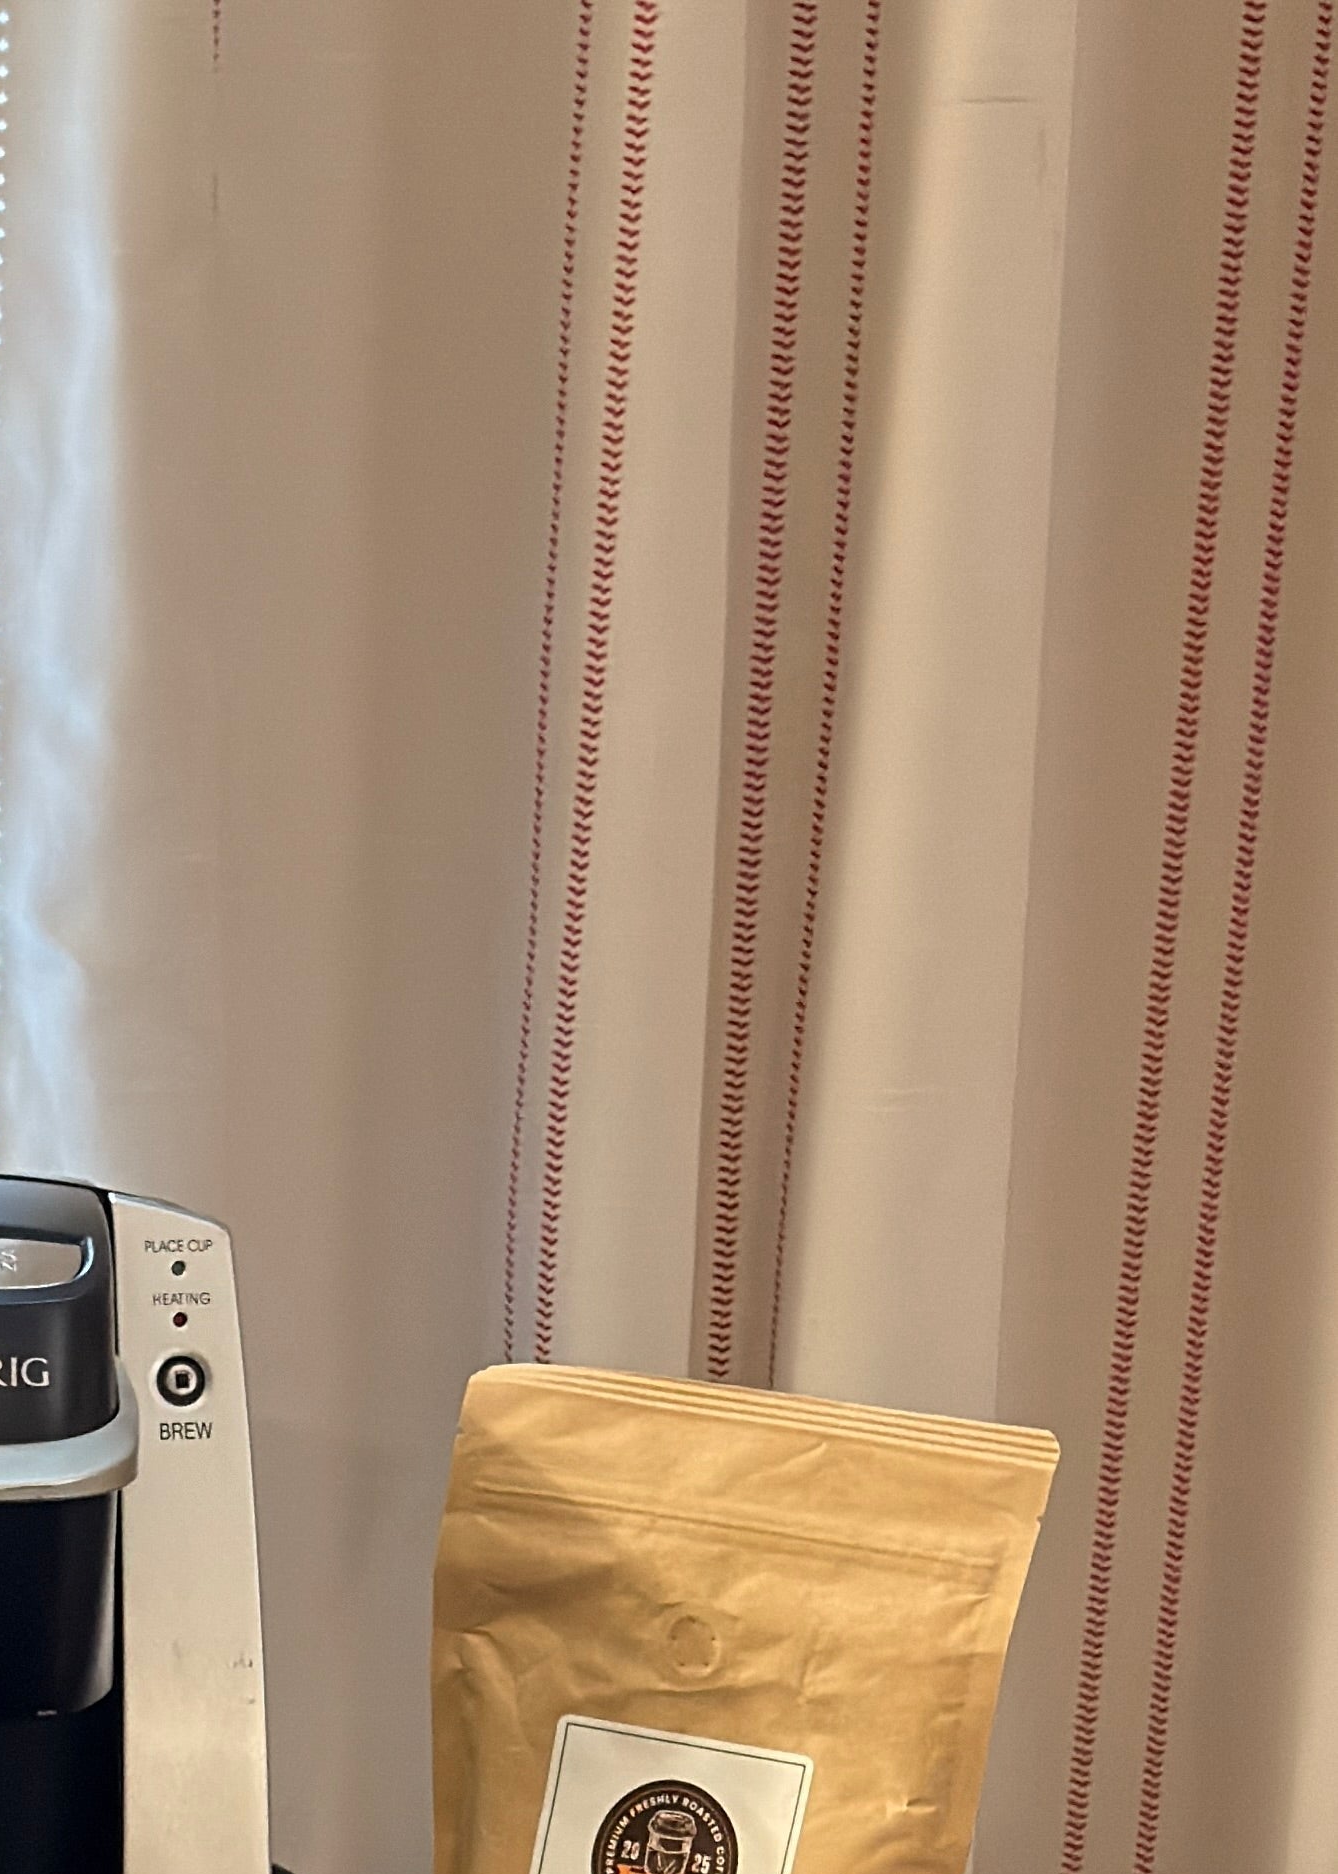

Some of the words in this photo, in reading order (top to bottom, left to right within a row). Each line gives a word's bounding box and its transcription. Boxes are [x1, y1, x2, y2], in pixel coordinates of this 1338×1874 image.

[144, 1239, 184, 1253] PLACE
[187, 1239, 213, 1253] CUP
[152, 1292, 211, 1306] HEATING
[160, 1422, 213, 1441] BREW
[605, 1815, 630, 1874] PREMIUM
[629, 1793, 680, 1818] FRESHLY
[682, 1796, 724, 1843] ROASTED
[691, 1853, 712, 1874] 25
